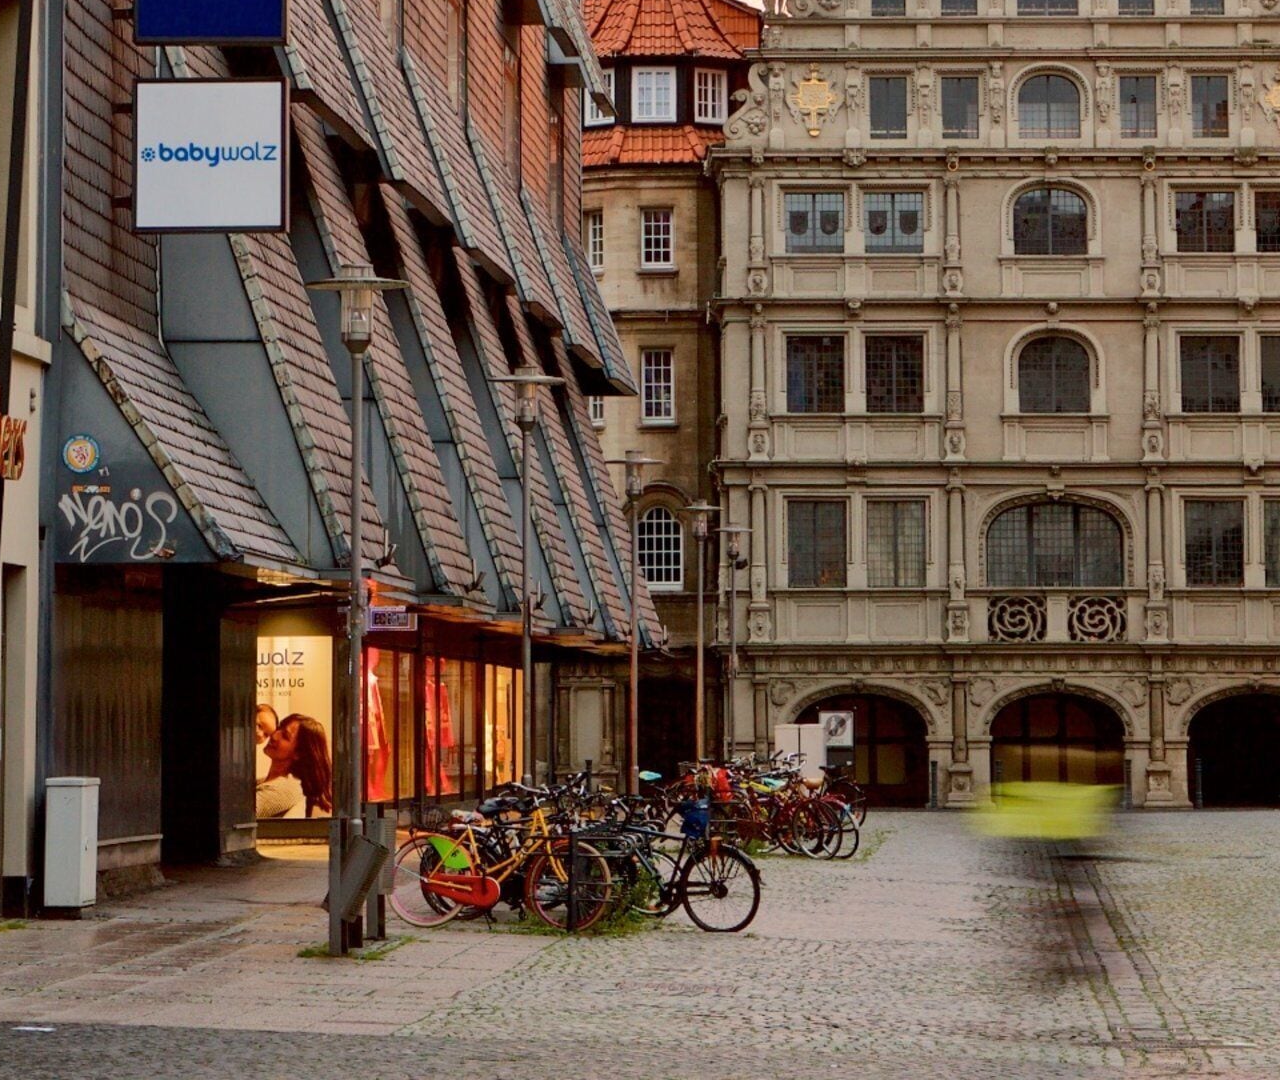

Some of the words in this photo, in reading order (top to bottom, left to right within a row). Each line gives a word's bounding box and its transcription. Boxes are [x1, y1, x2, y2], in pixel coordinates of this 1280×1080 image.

[158, 142, 278, 168] babywalz
[256, 648, 304, 666] walz
[271, 678, 286, 689] IM
[288, 678, 305, 689] UG
